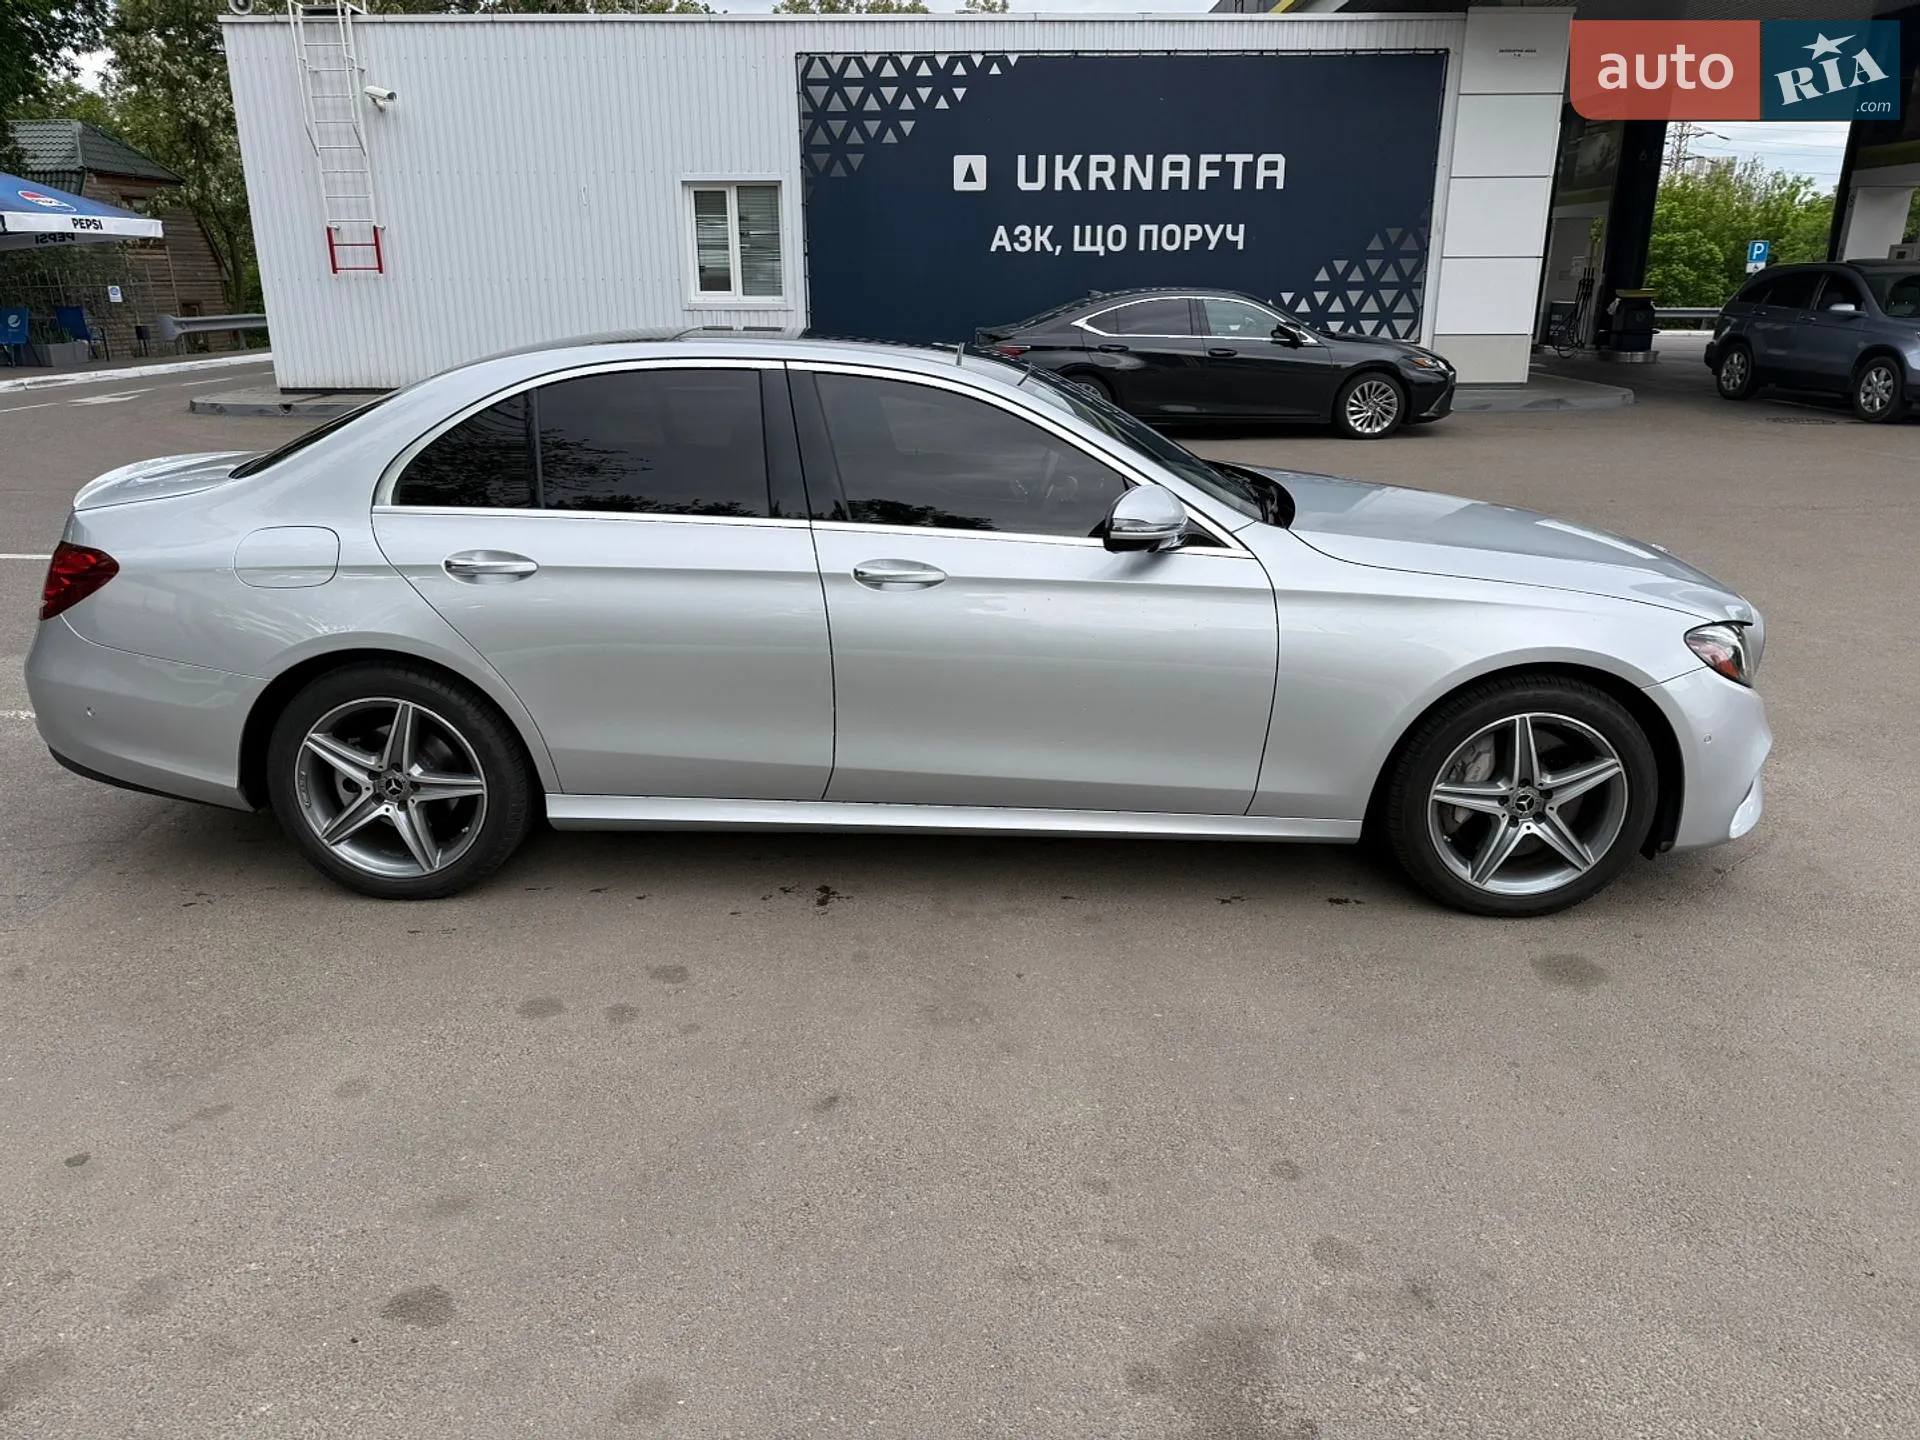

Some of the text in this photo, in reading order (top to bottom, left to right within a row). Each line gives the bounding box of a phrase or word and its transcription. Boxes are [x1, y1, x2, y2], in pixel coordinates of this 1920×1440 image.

[1016, 153, 1286, 191] UKRNAFTA
[71, 217, 104, 231] PEPSI
[990, 224, 1245, 257] АЗК, ЩО ПОРУЧ
[1752, 242, 1765, 260] P
